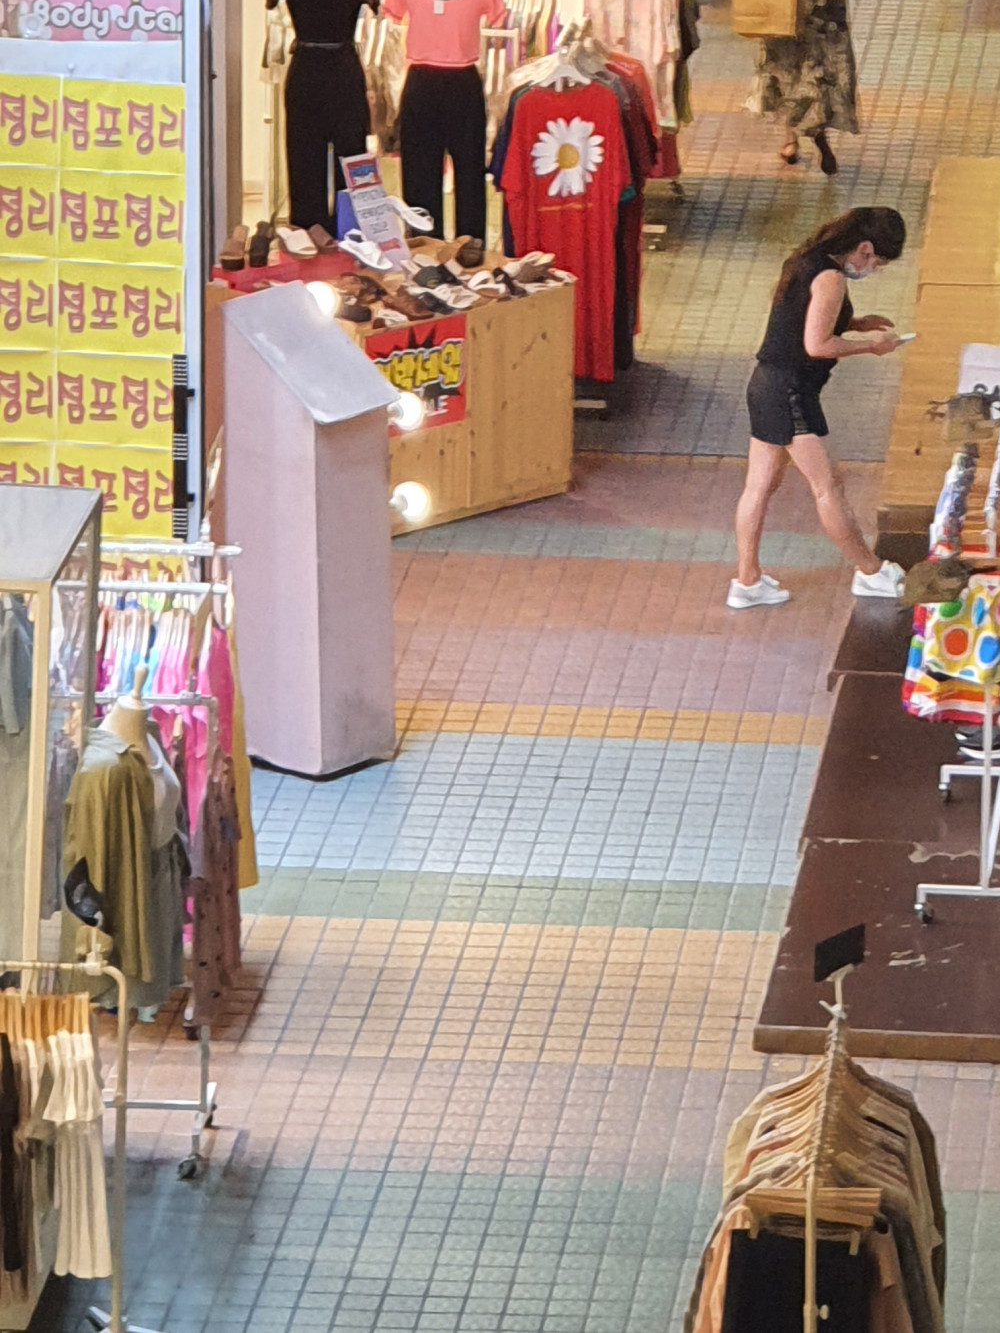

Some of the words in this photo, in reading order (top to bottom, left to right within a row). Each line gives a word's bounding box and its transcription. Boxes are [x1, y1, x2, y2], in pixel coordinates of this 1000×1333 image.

[62, 96, 186, 155] 점포정리
[60, 187, 184, 247] 점포정리
[58, 278, 181, 338] 점포정리
